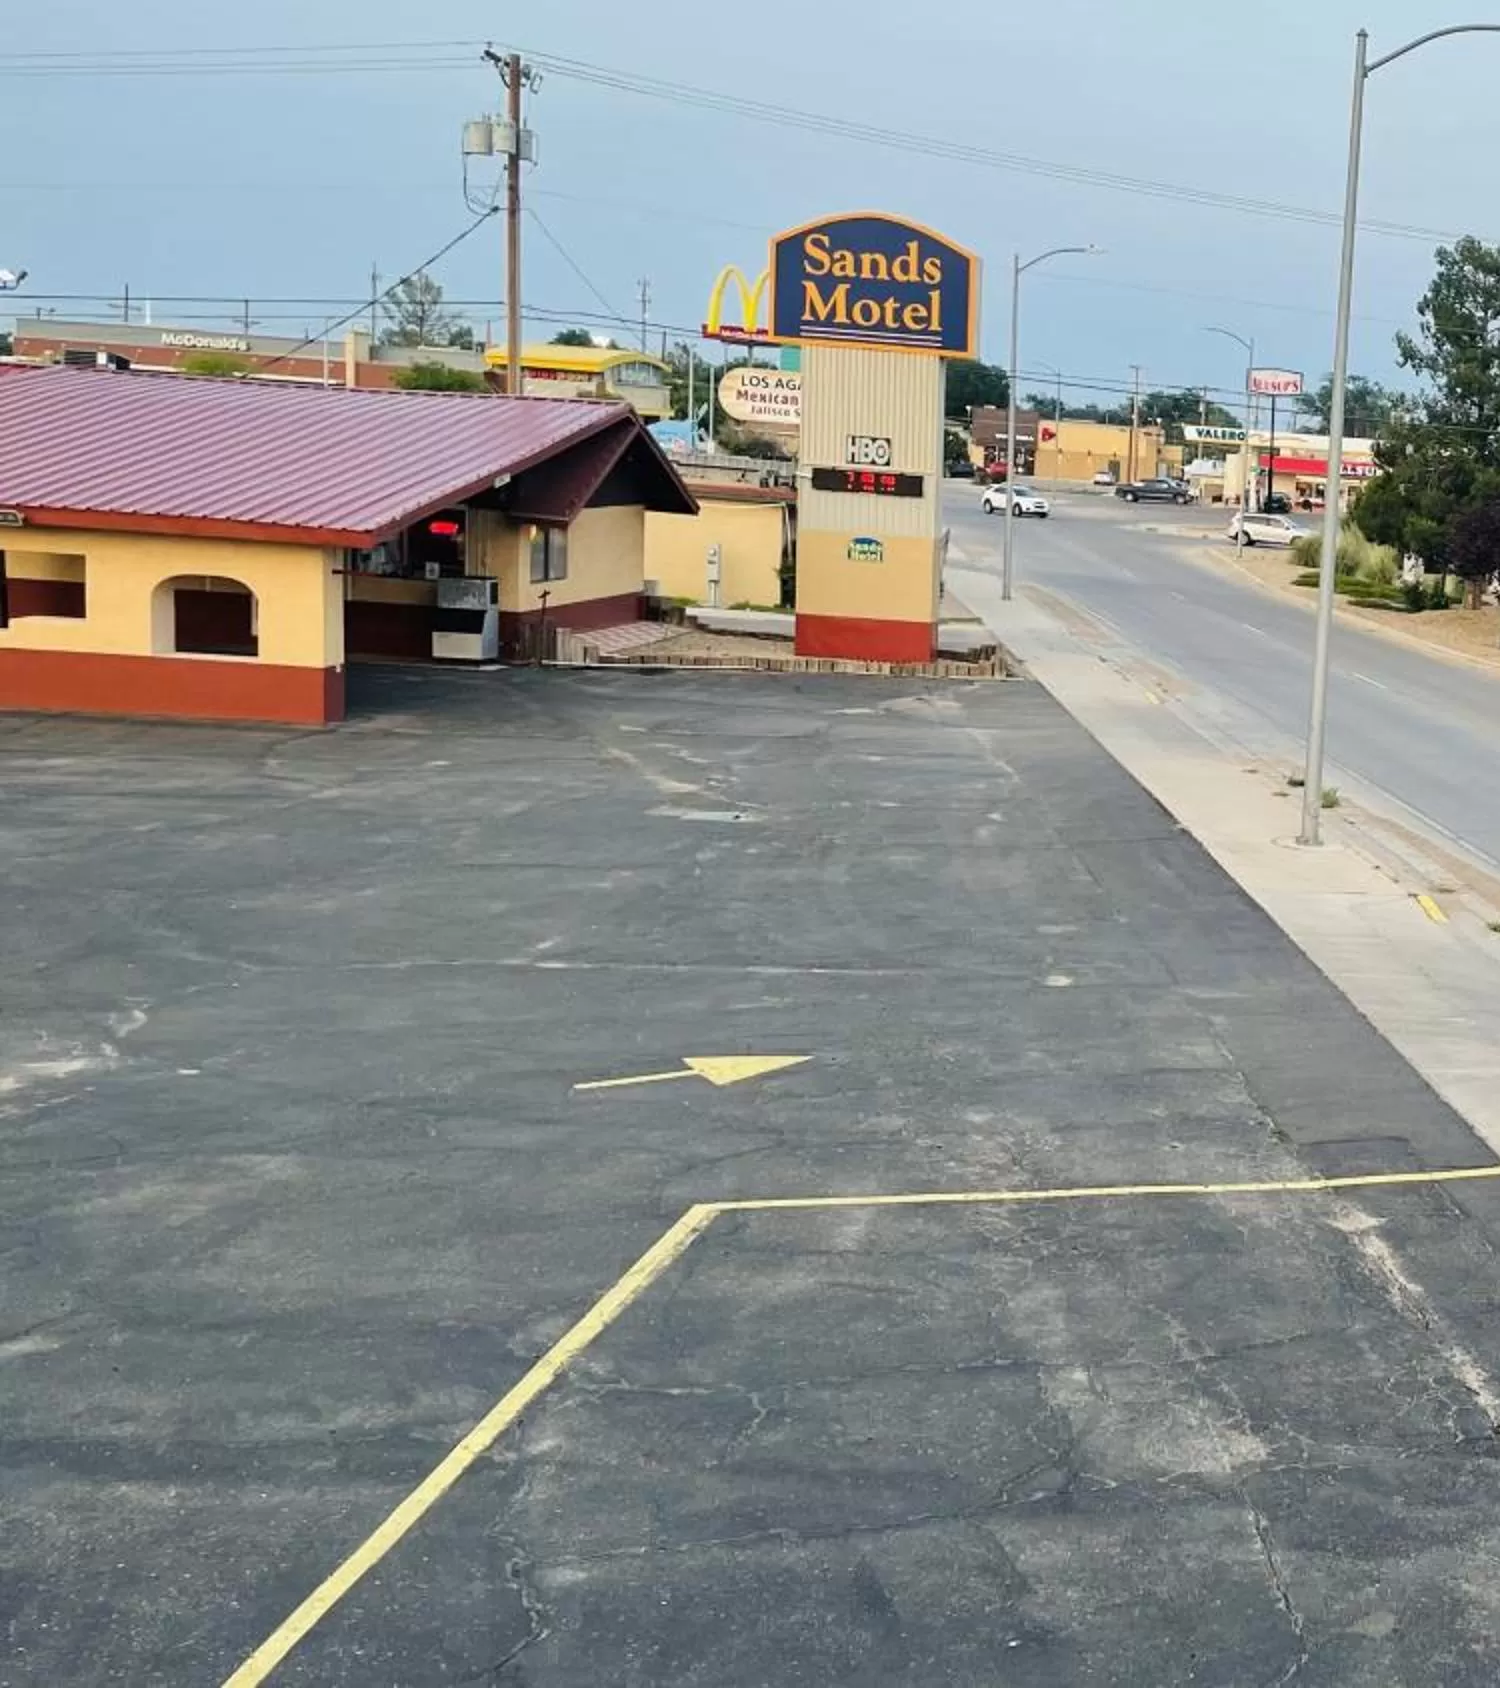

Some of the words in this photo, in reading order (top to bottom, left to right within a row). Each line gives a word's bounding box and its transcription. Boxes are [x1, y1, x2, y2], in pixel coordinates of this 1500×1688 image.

[803, 233, 942, 285] Sands
[801, 280, 943, 331] Motel
[741, 375, 769, 389] LOS
[736, 389, 799, 406] Mexican
[1195, 427, 1247, 441] VALERO
[846, 438, 890, 465] HBO
